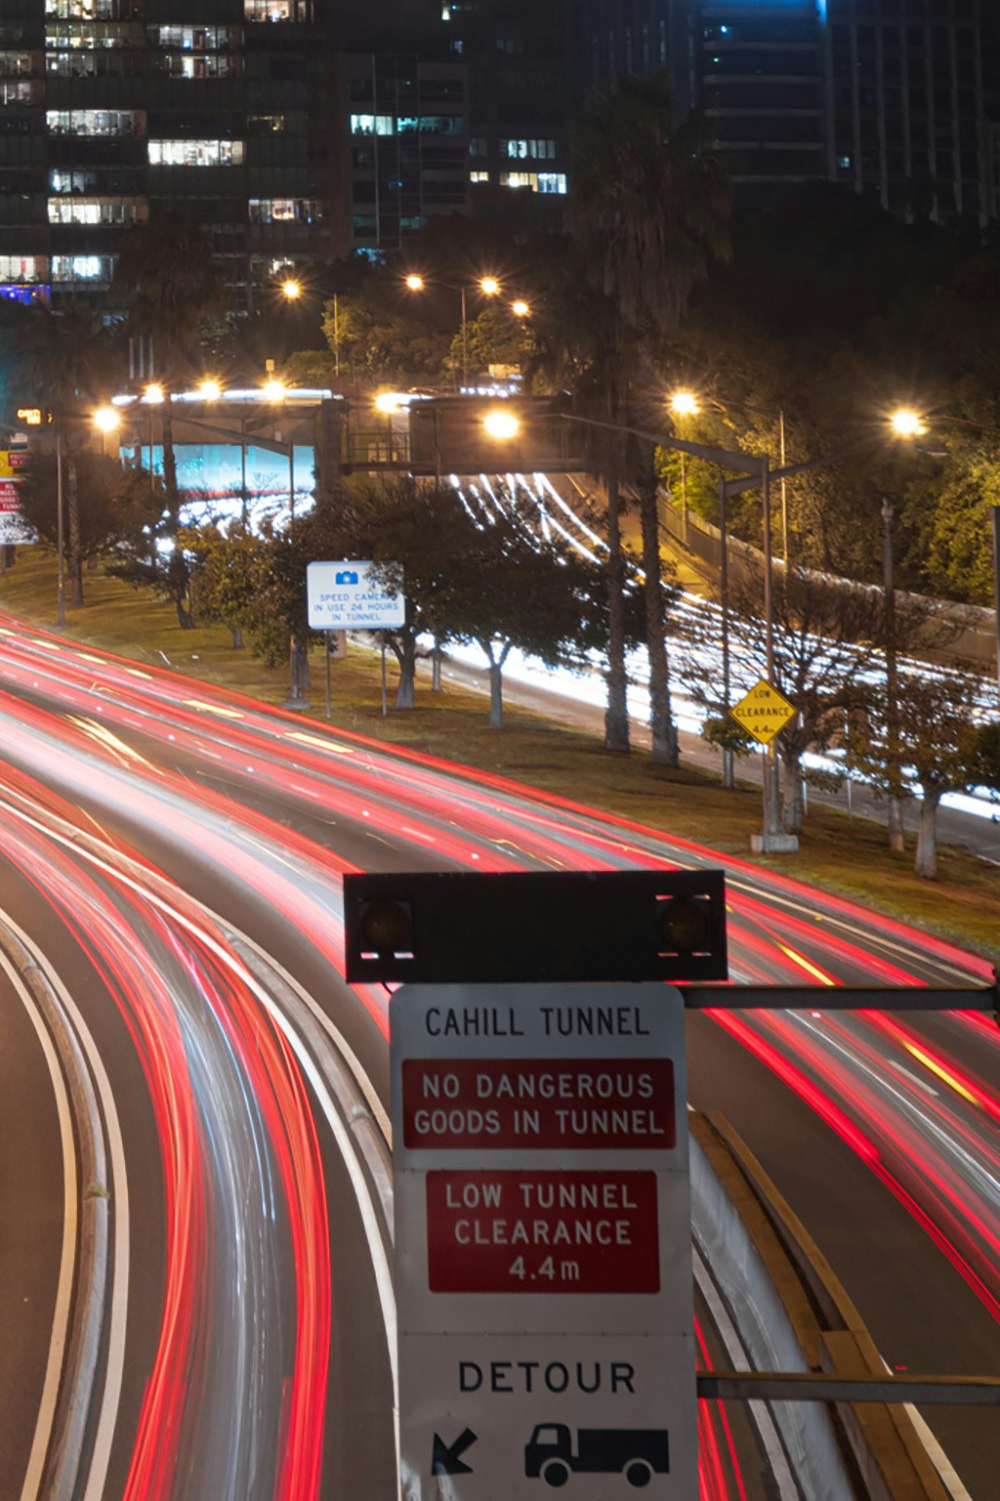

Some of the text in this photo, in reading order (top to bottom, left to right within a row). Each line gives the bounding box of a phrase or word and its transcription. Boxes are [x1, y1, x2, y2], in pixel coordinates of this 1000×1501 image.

[320, 593, 392, 602] SPEED CAMER
[351, 603, 362, 611] 24
[368, 603, 399, 611] HOURS
[346, 613, 381, 621] TUNNEL
[754, 690, 771, 699] LOW
[735, 707, 789, 717] CLEARANCE
[425, 1006, 650, 1037] CAHILL TUNNEL
[421, 1073, 655, 1100] NO DANGEROUS
[413, 1108, 665, 1136] GOODS IN TUNNEL
[445, 1182, 638, 1210] LOW TUNNEL
[454, 1218, 632, 1246] CLEARANCE
[508, 1255, 581, 1282] 4.4m
[458, 1361, 636, 1394] DETOUR
